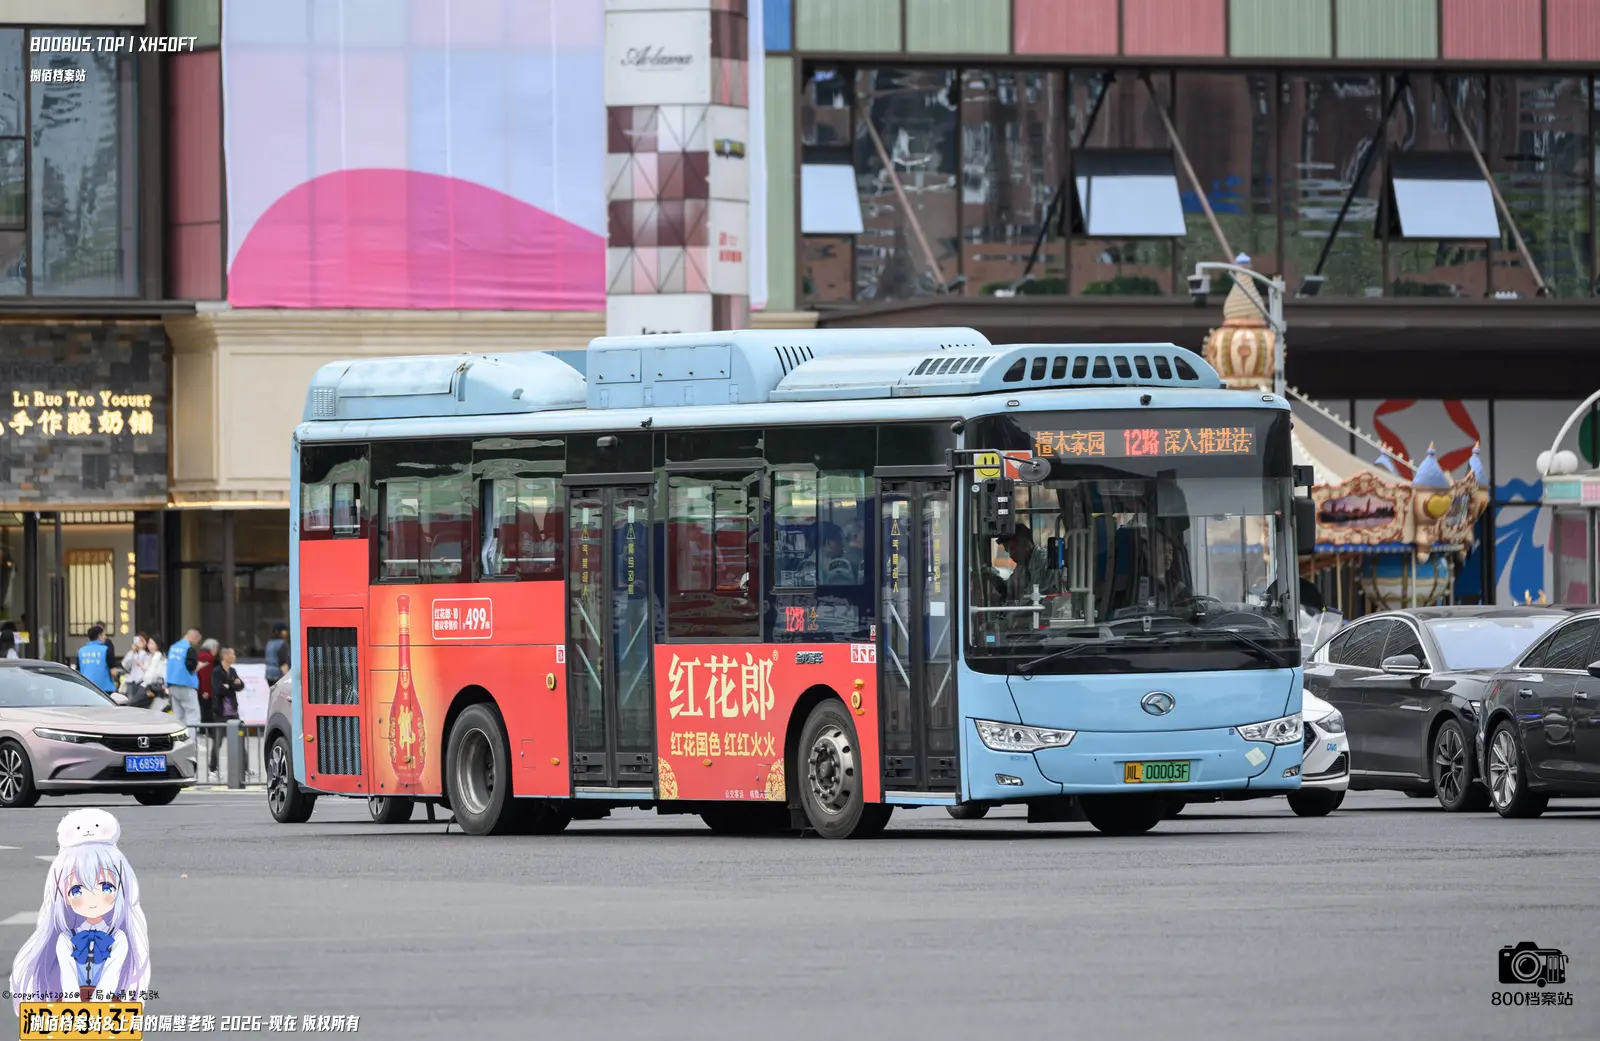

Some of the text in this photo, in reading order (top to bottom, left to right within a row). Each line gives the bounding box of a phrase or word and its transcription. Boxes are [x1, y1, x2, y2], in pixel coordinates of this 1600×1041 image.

[0, 408, 155, 436] 手作酸奶铺
[1034, 431, 1106, 457] 檀木家园
[1123, 428, 1160, 457] 12路
[668, 651, 776, 721] 红花郎
[670, 731, 776, 757] 红花国色 红红火火
